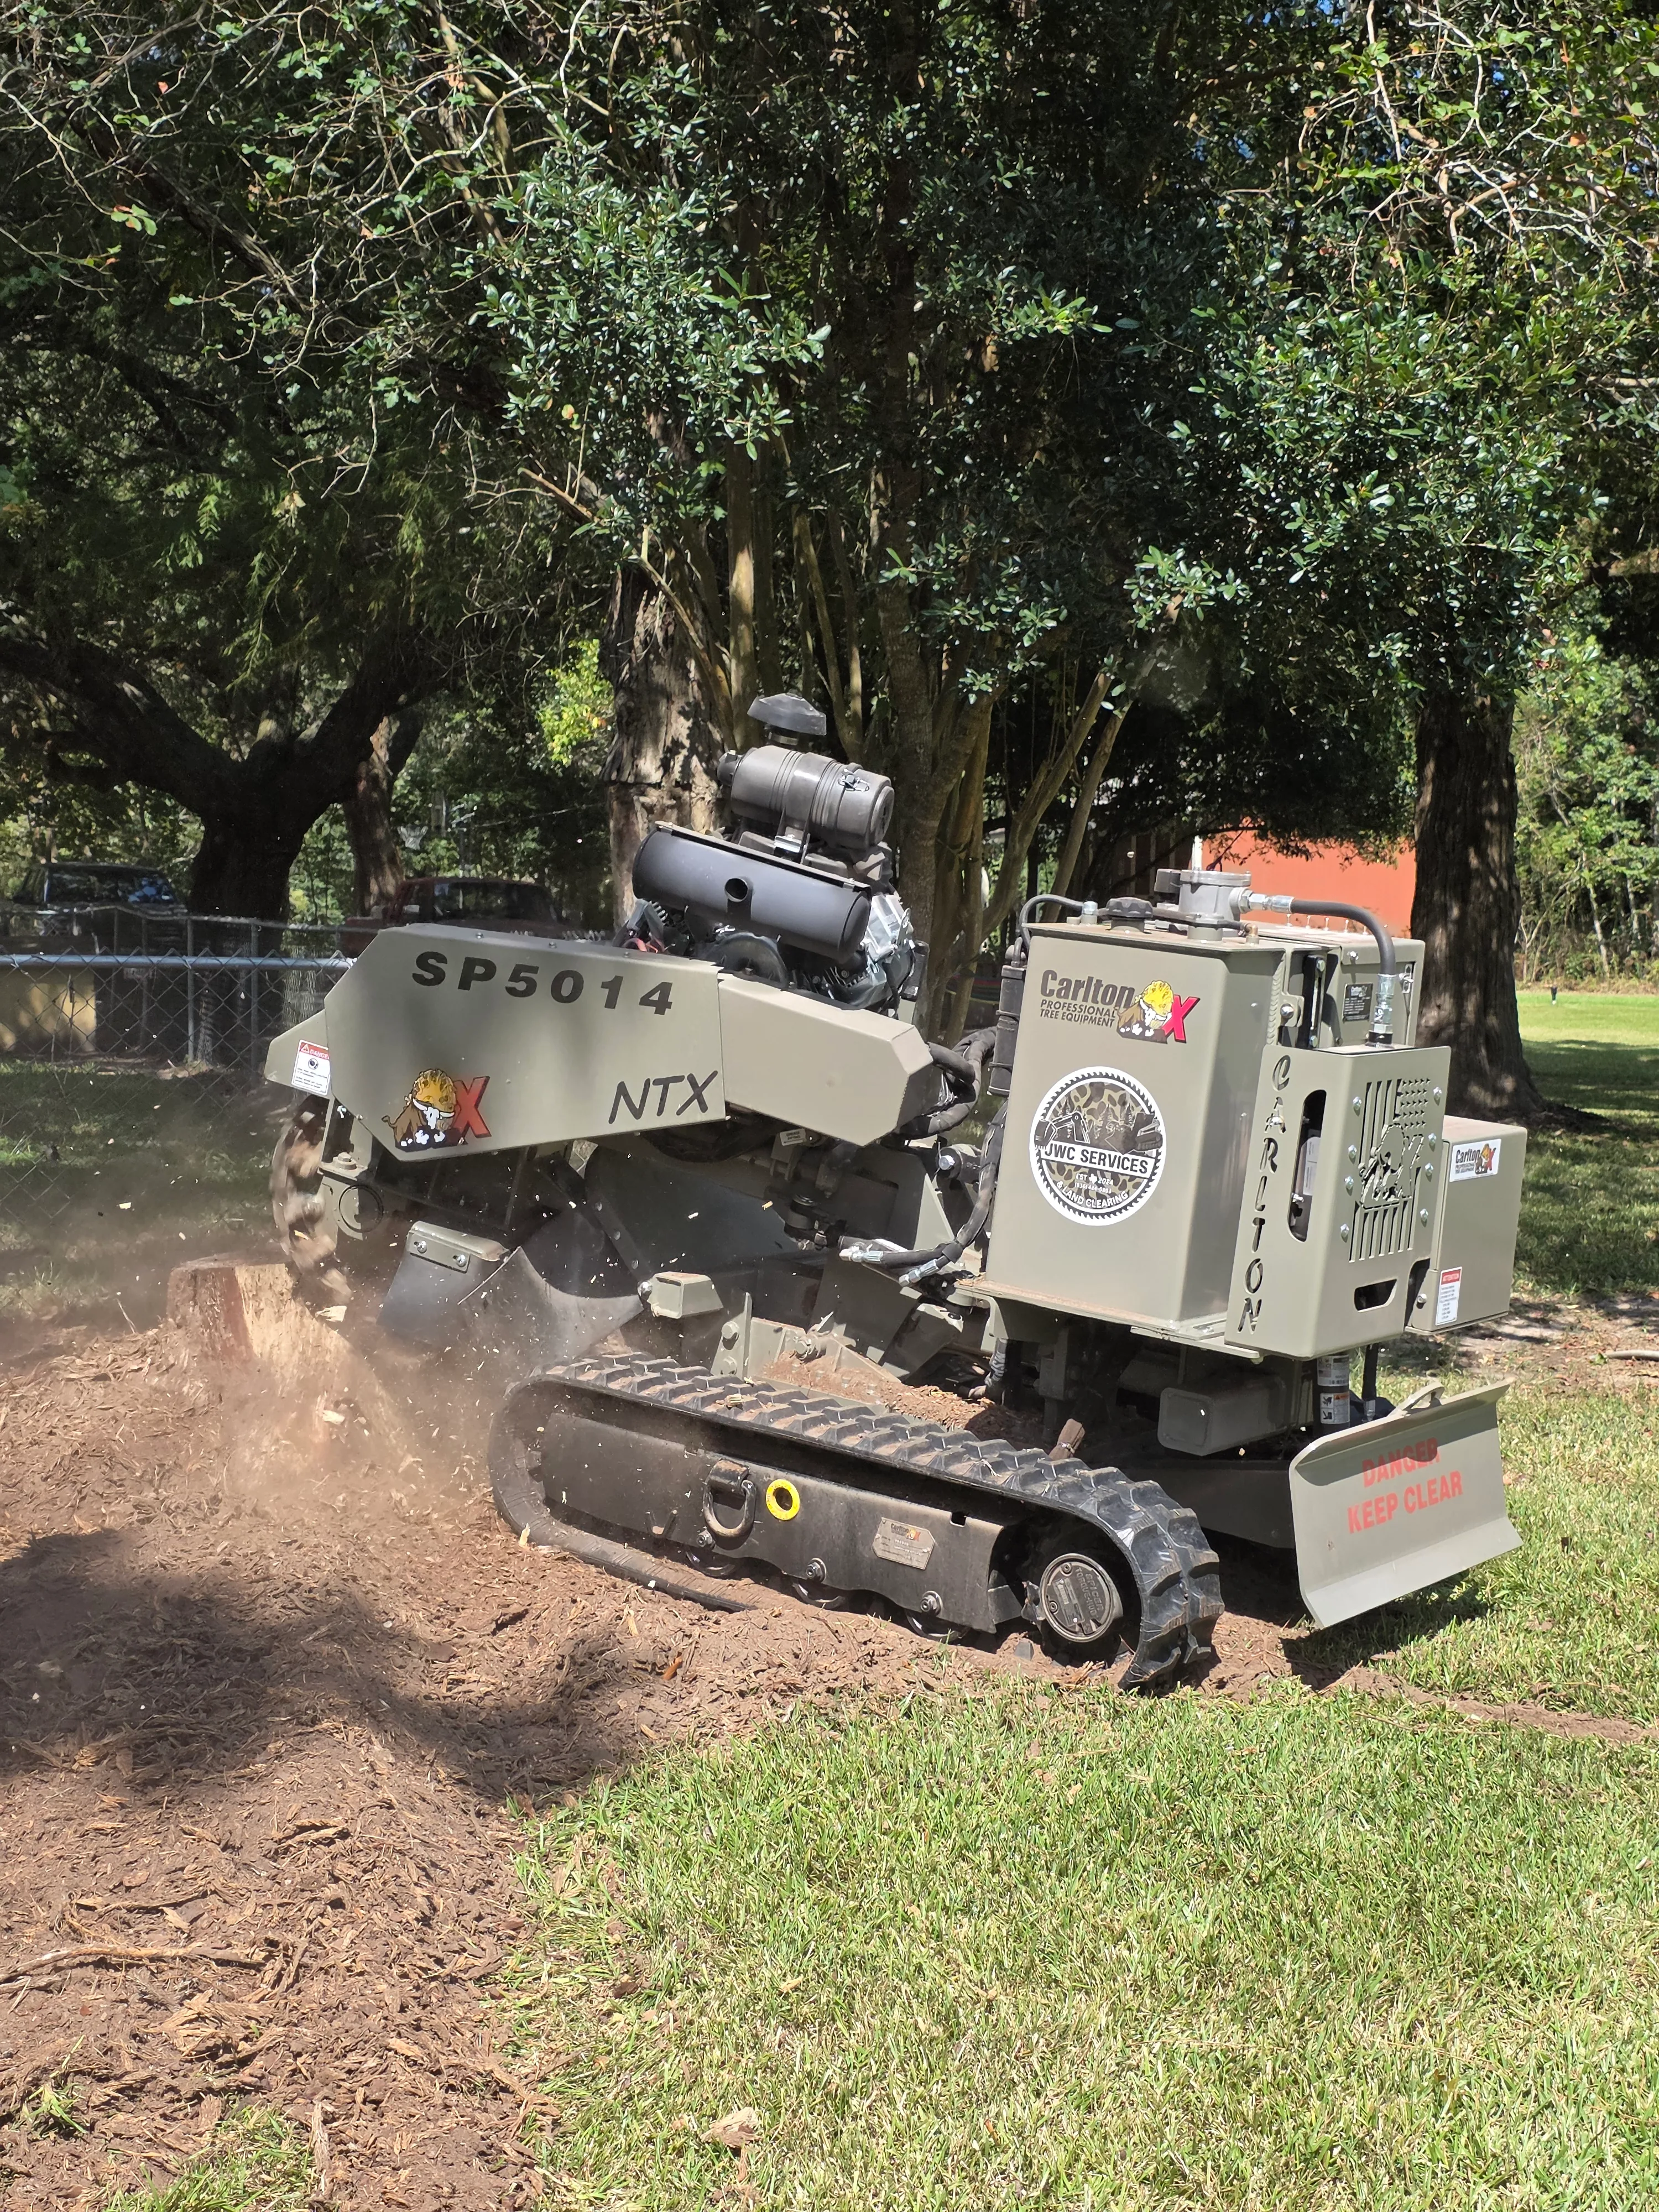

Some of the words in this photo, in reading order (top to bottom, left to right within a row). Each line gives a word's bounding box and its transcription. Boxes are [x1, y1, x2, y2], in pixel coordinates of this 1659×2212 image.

[412, 951, 673, 1015] SP5014
[1040, 969, 1135, 1009] Carlton
[1040, 999, 1116, 1018] PROFESSIONAL
[1040, 1008, 1059, 1019] TREE
[1061, 1011, 1115, 1028] EQUIPMENT
[608, 1070, 718, 1124] NTX
[1045, 1143, 1076, 1160] JWC
[1080, 1149, 1148, 1174] SERVICES
[1455, 1149, 1481, 1164] Carlton
[1062, 1186, 1084, 1205] LAND
[1086, 1191, 1129, 1208] CLEARING
[1237, 1055, 1291, 1335] CARLTON
[1362, 1437, 1440, 1488] DANGER
[1347, 1491, 1399, 1534] KEEP
[1404, 1470, 1463, 1514] CLEAR
[1075, 1567, 1097, 1616] TORQUE-HUB
[1086, 1573, 1104, 1611] SPICER
